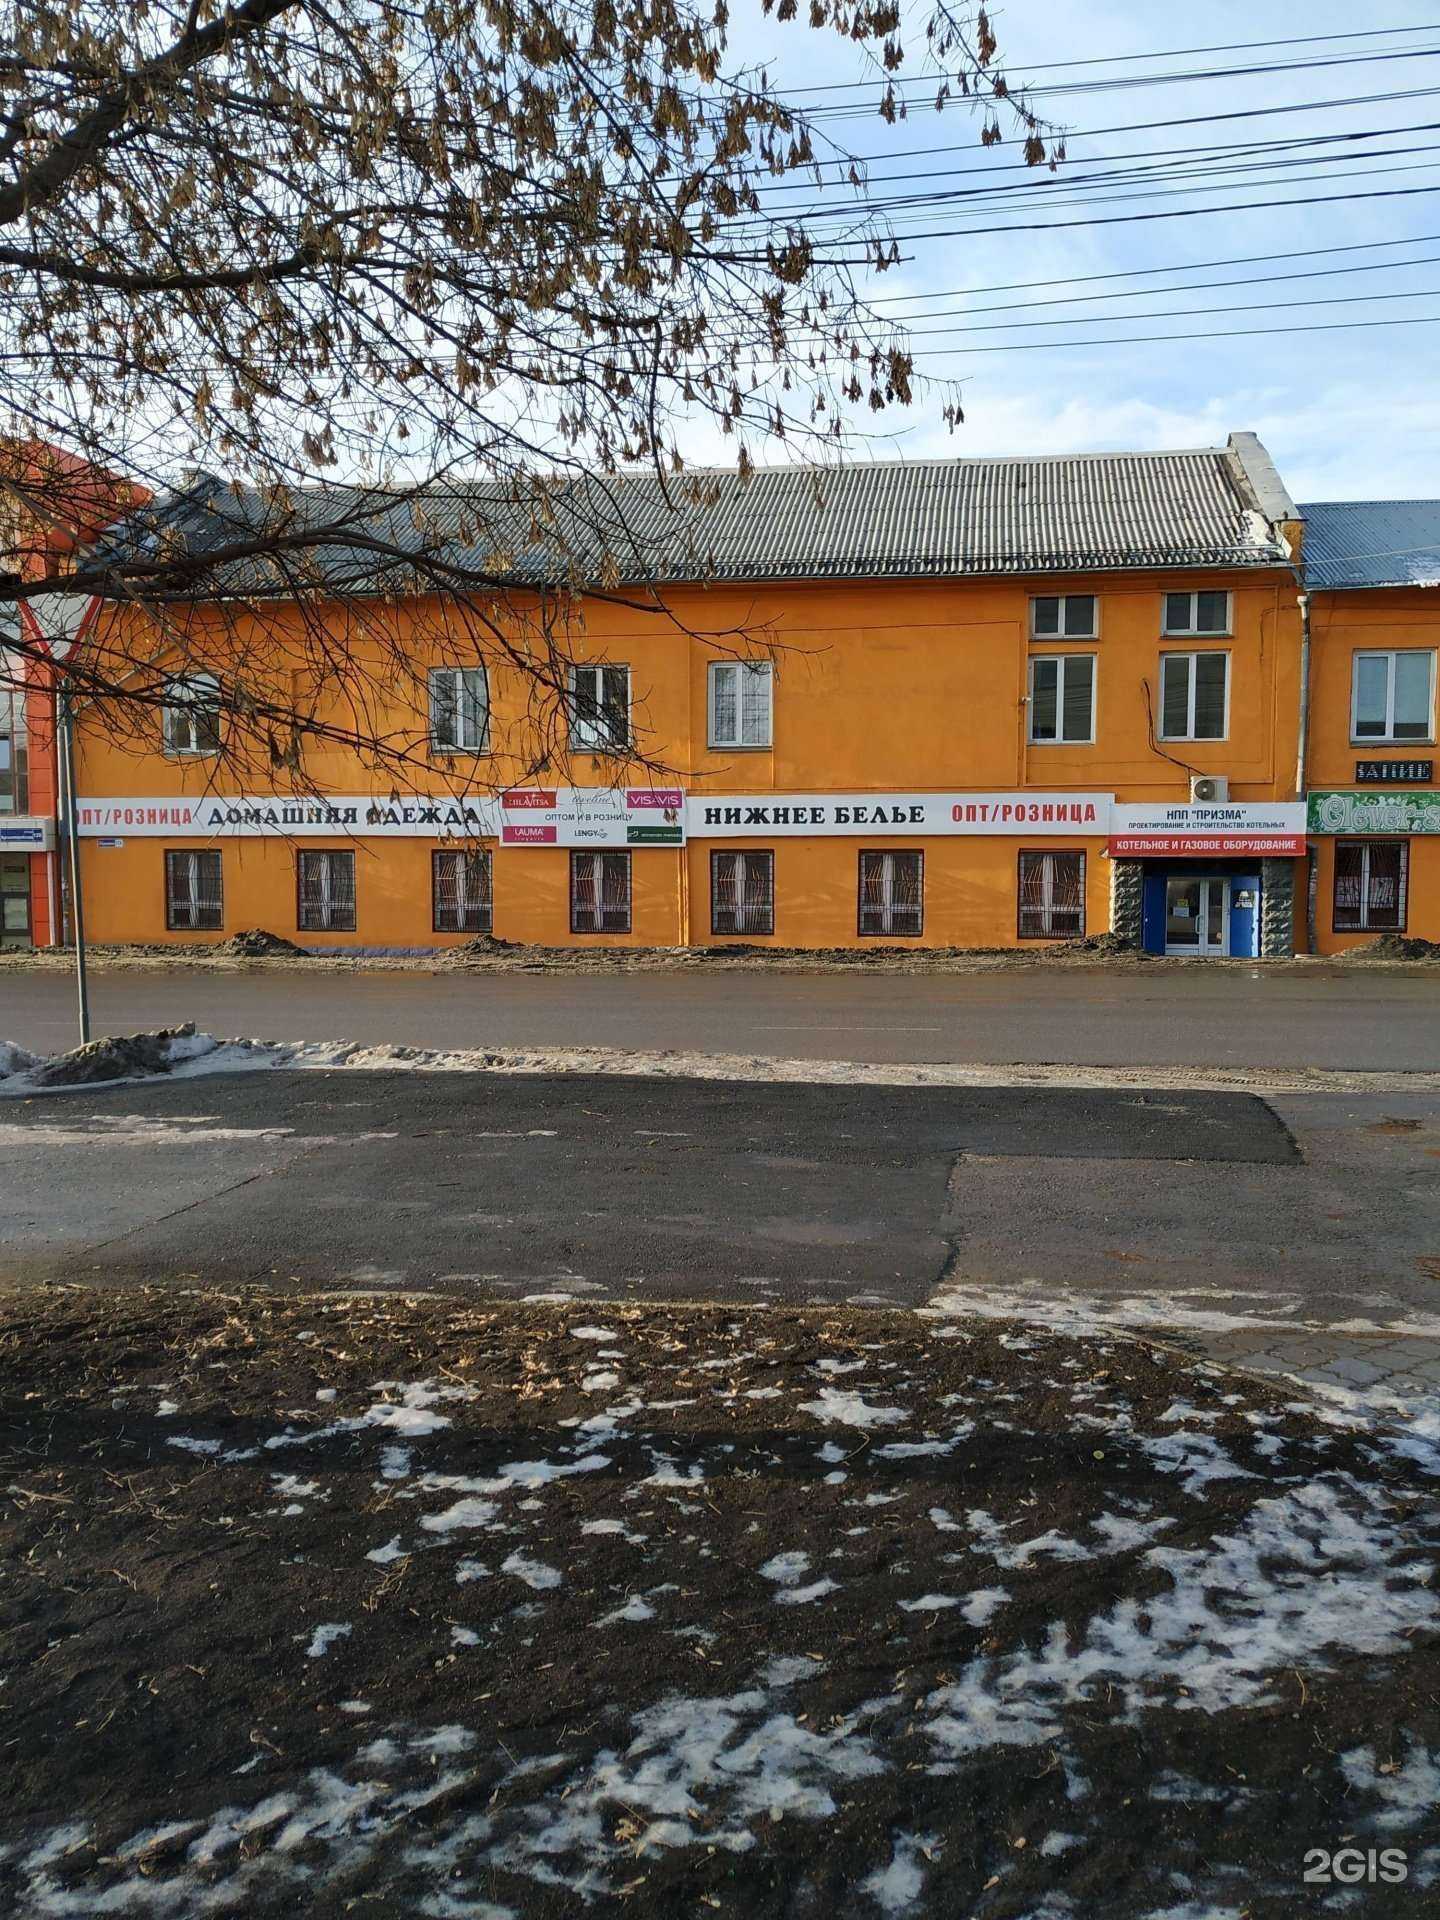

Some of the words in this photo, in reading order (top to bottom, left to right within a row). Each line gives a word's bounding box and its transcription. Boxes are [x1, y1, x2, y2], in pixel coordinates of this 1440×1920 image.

[208, 807, 358, 826] ДОМАШНЯЯ
[545, 813, 575, 821] ОПТОМ
[578, 813, 583, 821] И
[586, 813, 591, 821] В
[594, 813, 633, 822] РОЗНИЦУ
[704, 807, 825, 825] НИЖНЕЕ
[834, 805, 925, 824] БЕЛЬЕ
[952, 803, 1096, 824] ОПТ/РОЗНИЦА
[1167, 810, 1188, 820] НПП
[1192, 810, 1246, 820] "ПРИЗМА"
[1116, 840, 1170, 850] КОТЕЛЬНОЕ
[1171, 840, 1179, 850] И
[1181, 840, 1220, 850] ГАЗОВОЕ
[1222, 840, 1296, 851] ОБОРУДОВАНИЕ
